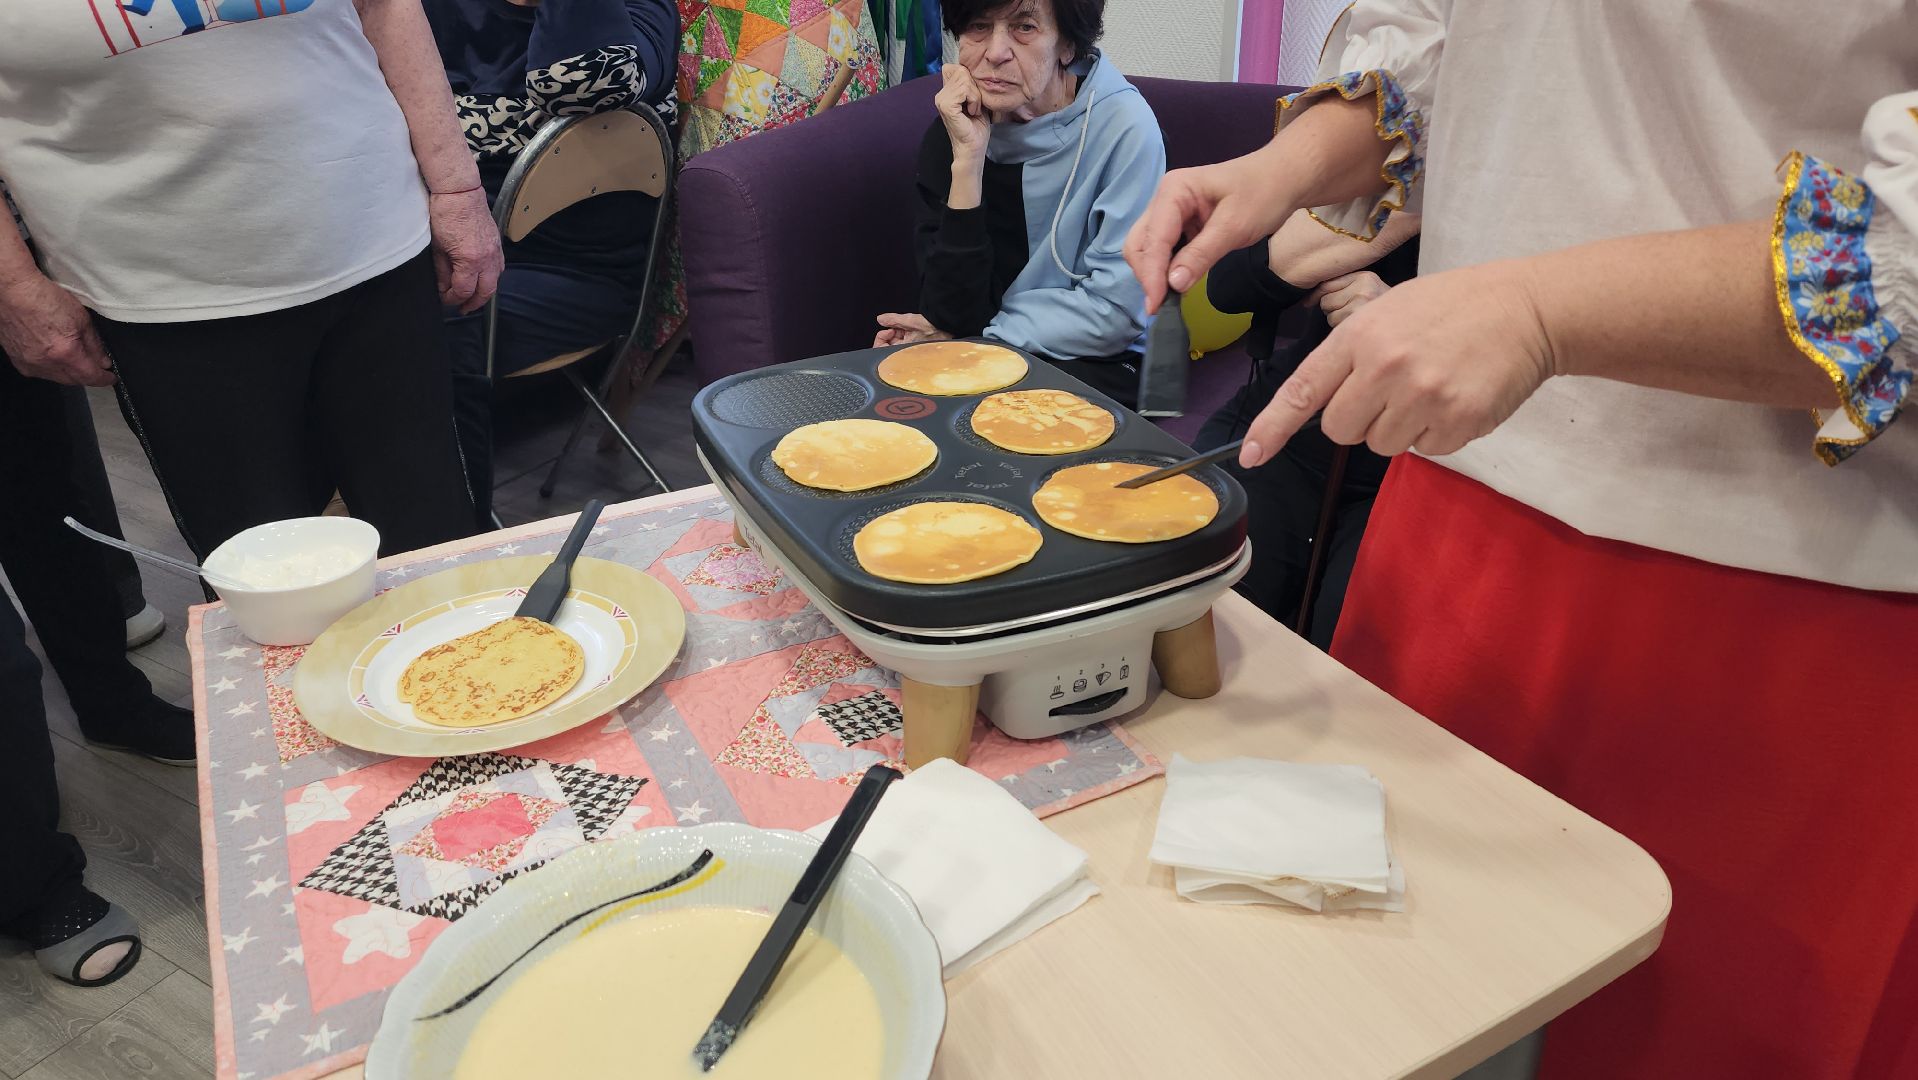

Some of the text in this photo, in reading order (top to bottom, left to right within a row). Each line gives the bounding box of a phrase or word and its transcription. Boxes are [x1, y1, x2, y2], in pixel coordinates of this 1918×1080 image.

[955, 461, 984, 479] Tefal
[999, 461, 1024, 479] Tefal
[967, 481, 1010, 490] Tefal
